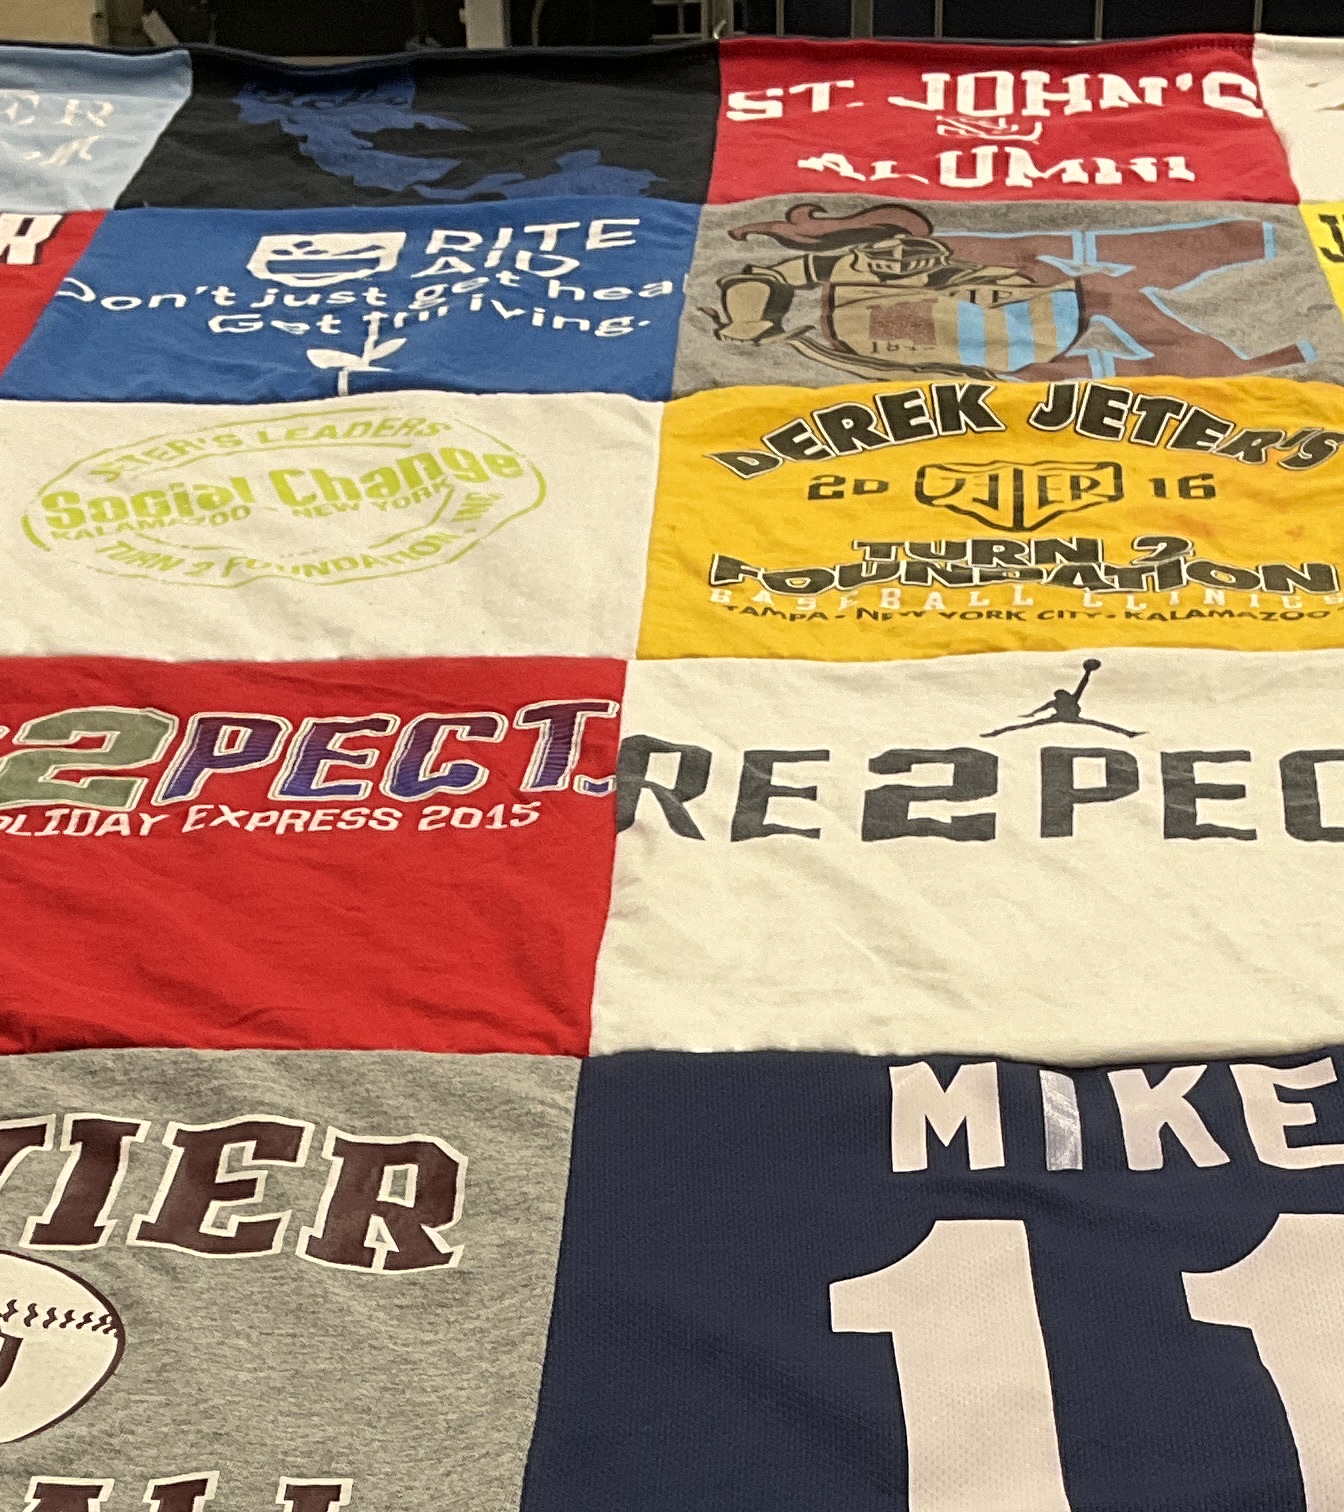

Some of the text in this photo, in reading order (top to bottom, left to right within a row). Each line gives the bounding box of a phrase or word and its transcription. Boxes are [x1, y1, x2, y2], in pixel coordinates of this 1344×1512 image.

[888, 70, 1265, 118] JOHN'S
[797, 145, 1196, 188] ALUMNI
[425, 218, 641, 255] RITE
[410, 247, 581, 278] AID
[250, 286, 388, 308] just
[408, 269, 521, 310] get
[547, 273, 690, 301] hea
[207, 313, 342, 335] Get
[257, 416, 453, 444] LEADERS
[704, 382, 1007, 480] DEREK
[41, 446, 525, 530] Social Change
[1152, 473, 1218, 500] 16
[852, 534, 1195, 566] TURN 2
[709, 552, 1342, 596] FOUNDATION
[183, 801, 401, 834] EXPRESS
[417, 800, 542, 832] 2015
